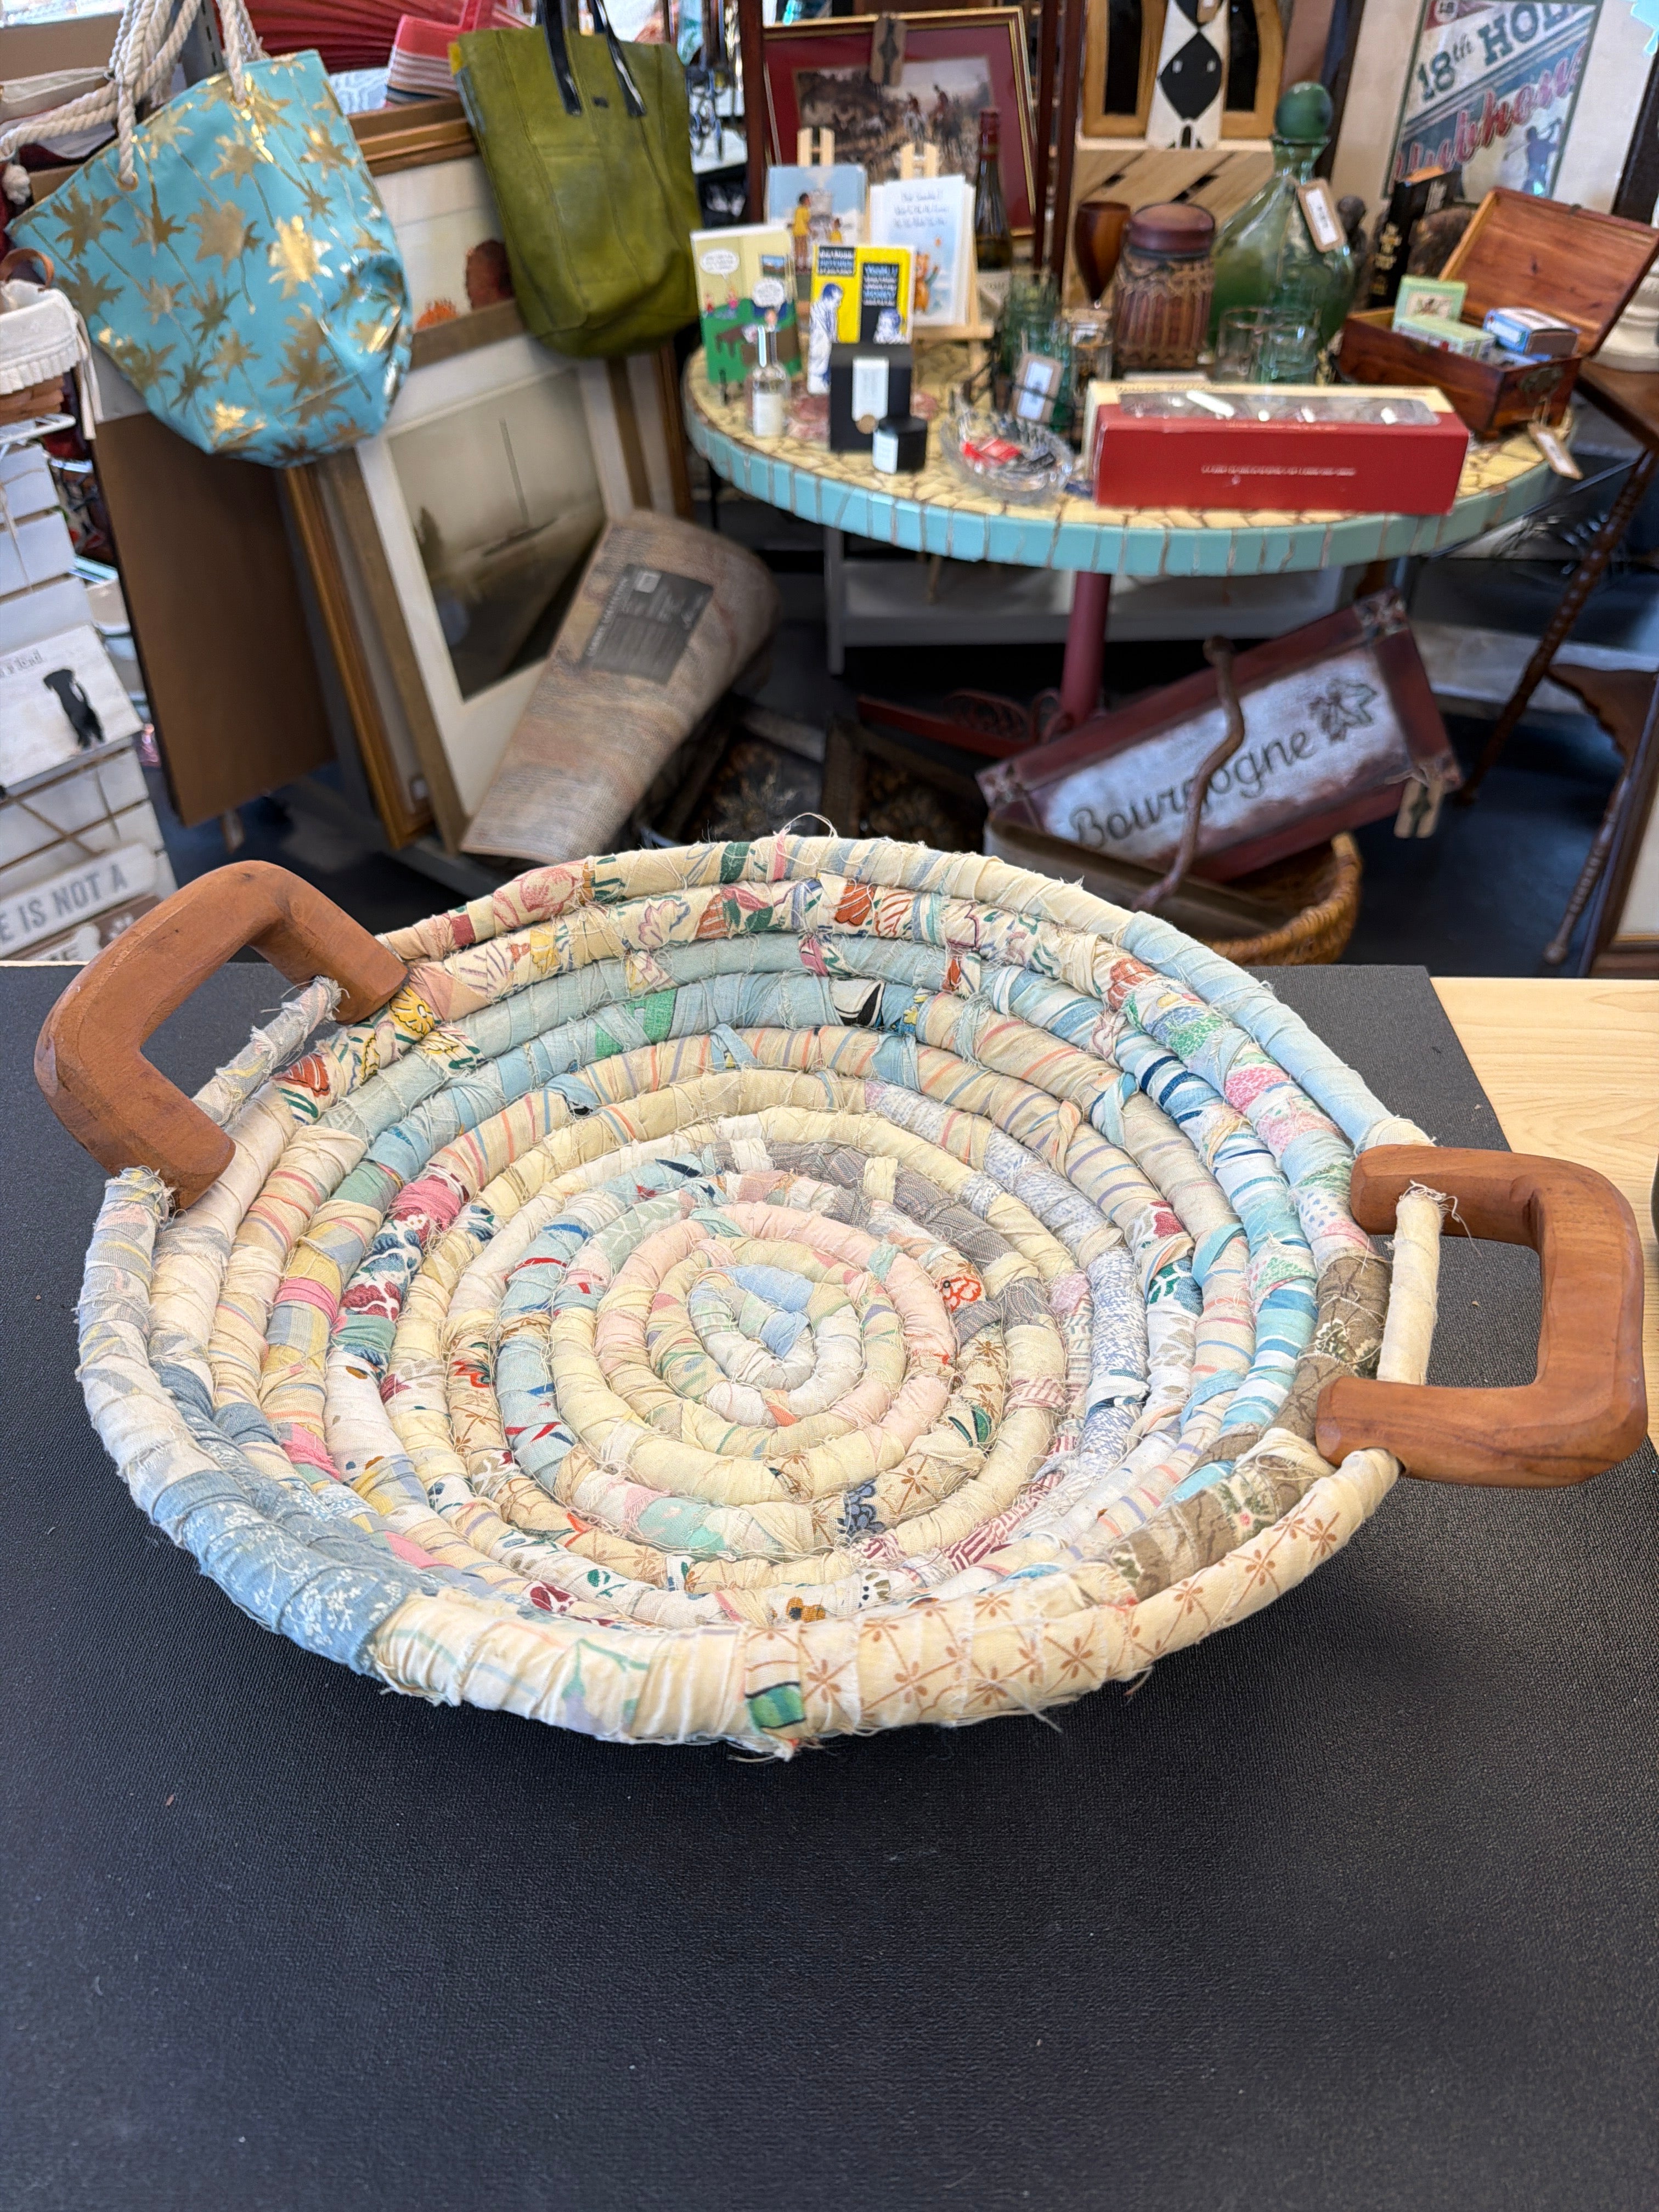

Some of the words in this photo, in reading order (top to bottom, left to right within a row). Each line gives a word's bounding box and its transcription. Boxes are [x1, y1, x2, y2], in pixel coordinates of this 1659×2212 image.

[1418, 33, 1474, 101] 18th
[1477, 3, 1583, 65] HOL
[1390, 42, 1588, 183] lubhous
[18, 898, 47, 932] IS
[52, 871, 100, 917] NOT
[111, 863, 128, 893] A
